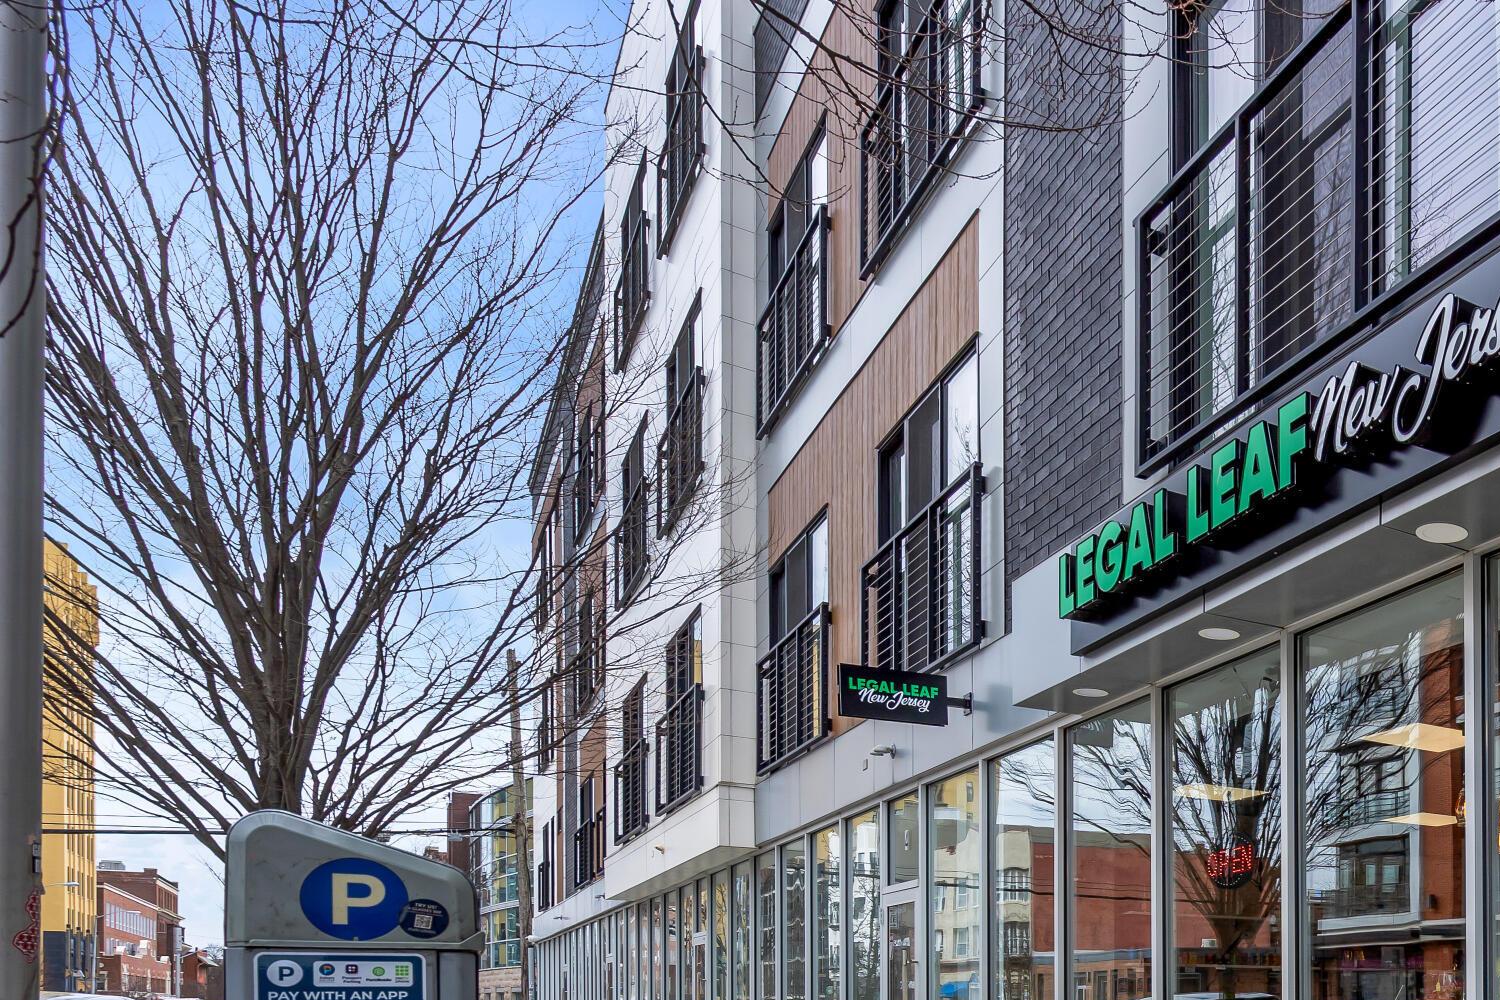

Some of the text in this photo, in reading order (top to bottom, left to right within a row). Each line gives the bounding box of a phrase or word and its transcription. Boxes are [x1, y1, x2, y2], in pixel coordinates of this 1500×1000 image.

[1059, 488, 1176, 620] LEGAL
[1186, 391, 1310, 544] LEAF
[1311, 360, 1401, 462] New
[848, 677, 938, 698] LEGAL LEAF
[858, 688, 930, 712] New Jersey
[1207, 844, 1252, 877] OPEN
[332, 872, 386, 925] P
[278, 966, 294, 981] P
[268, 991, 408, 1000] PAY WITH AN APP
